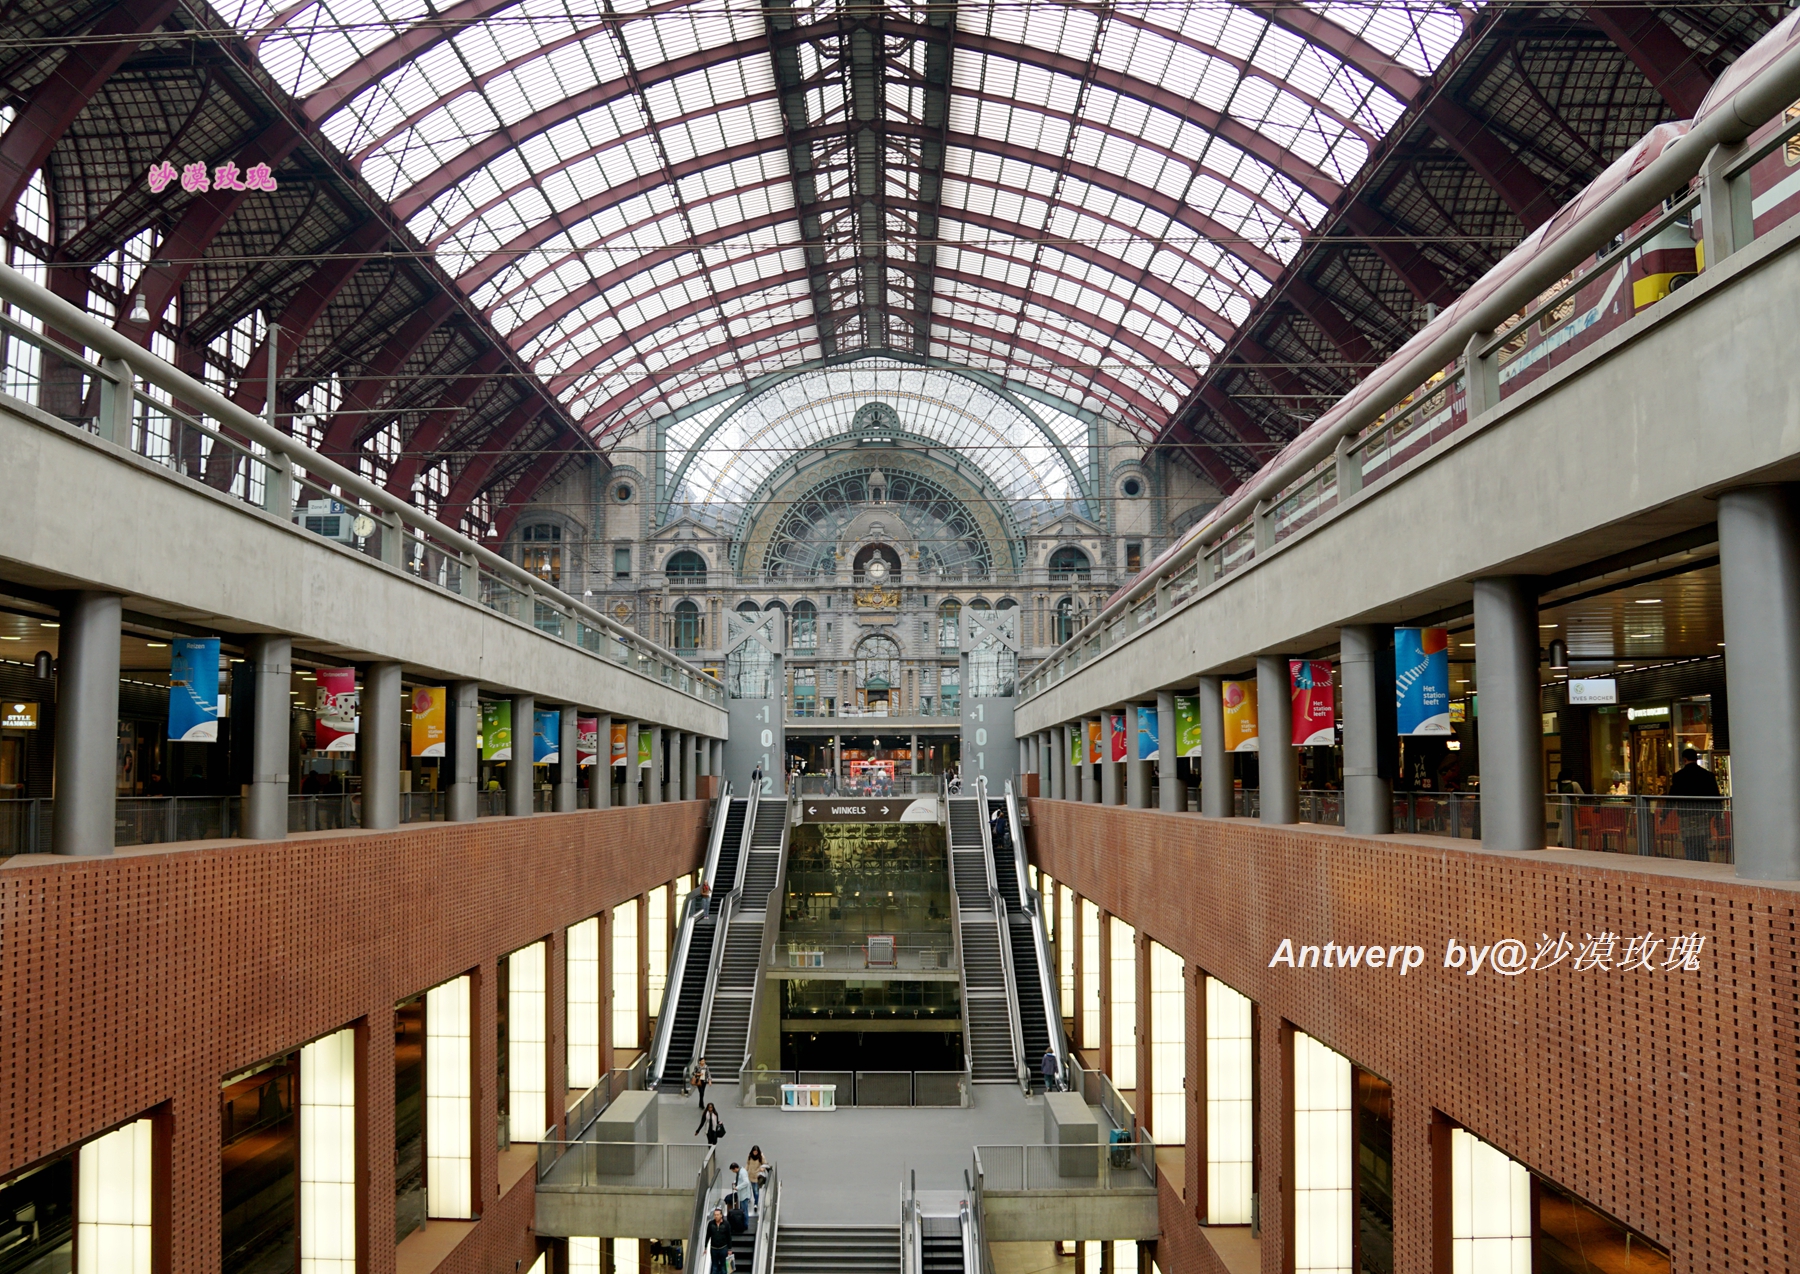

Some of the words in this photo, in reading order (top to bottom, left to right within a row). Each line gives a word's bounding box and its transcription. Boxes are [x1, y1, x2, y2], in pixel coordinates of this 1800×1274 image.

[334, 503, 341, 512] 3
[761, 729, 773, 747] 0
[975, 727, 988, 746] 0
[831, 806, 867, 815] WINKELS
